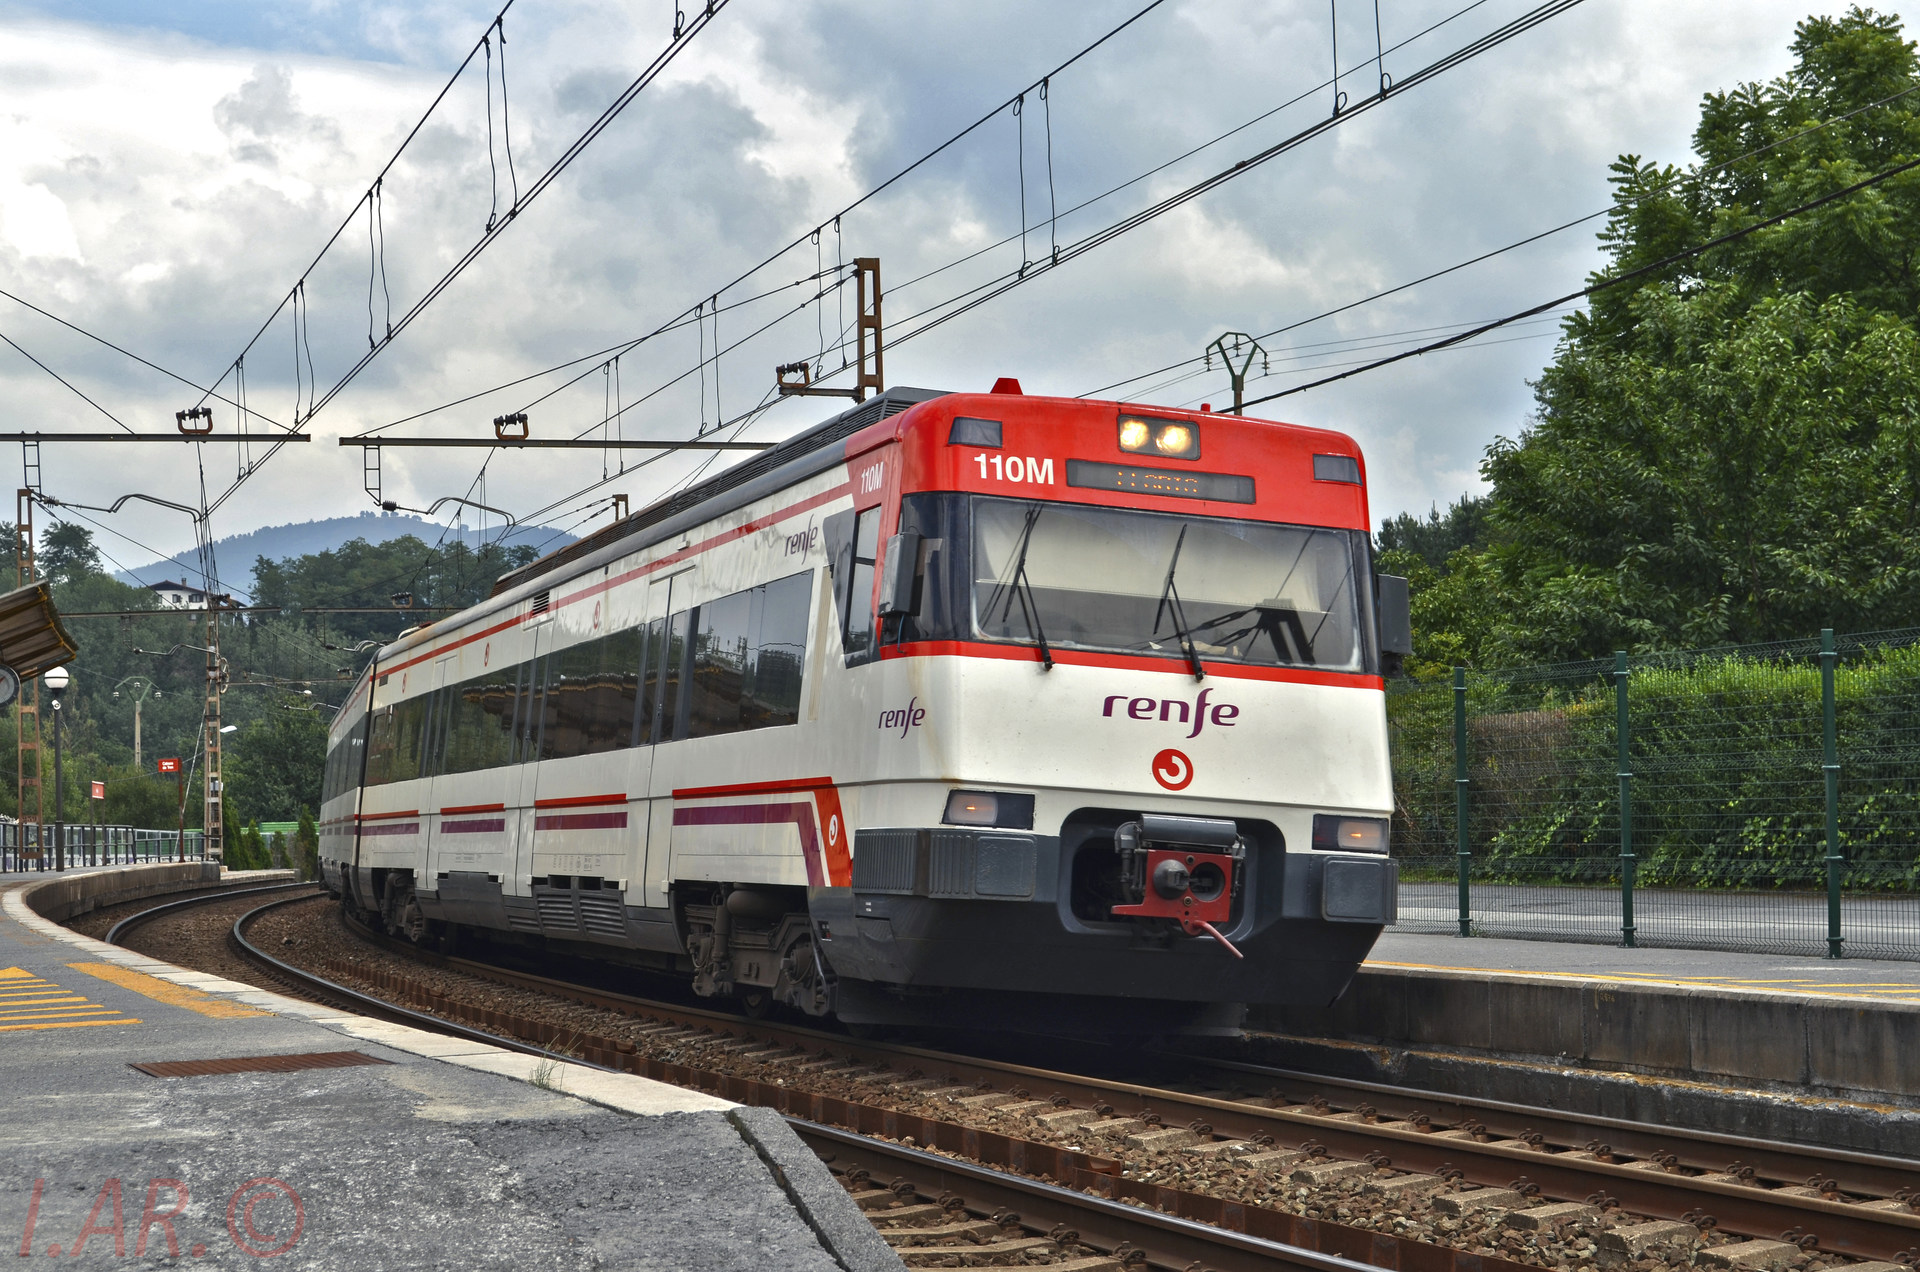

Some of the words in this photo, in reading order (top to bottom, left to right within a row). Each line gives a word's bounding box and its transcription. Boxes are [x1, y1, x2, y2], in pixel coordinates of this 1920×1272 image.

[861, 461, 884, 495] 110M
[974, 453, 1054, 485] 110M
[784, 513, 818, 566] renfe
[878, 696, 926, 740] renfe
[1102, 687, 1240, 739] renfe
